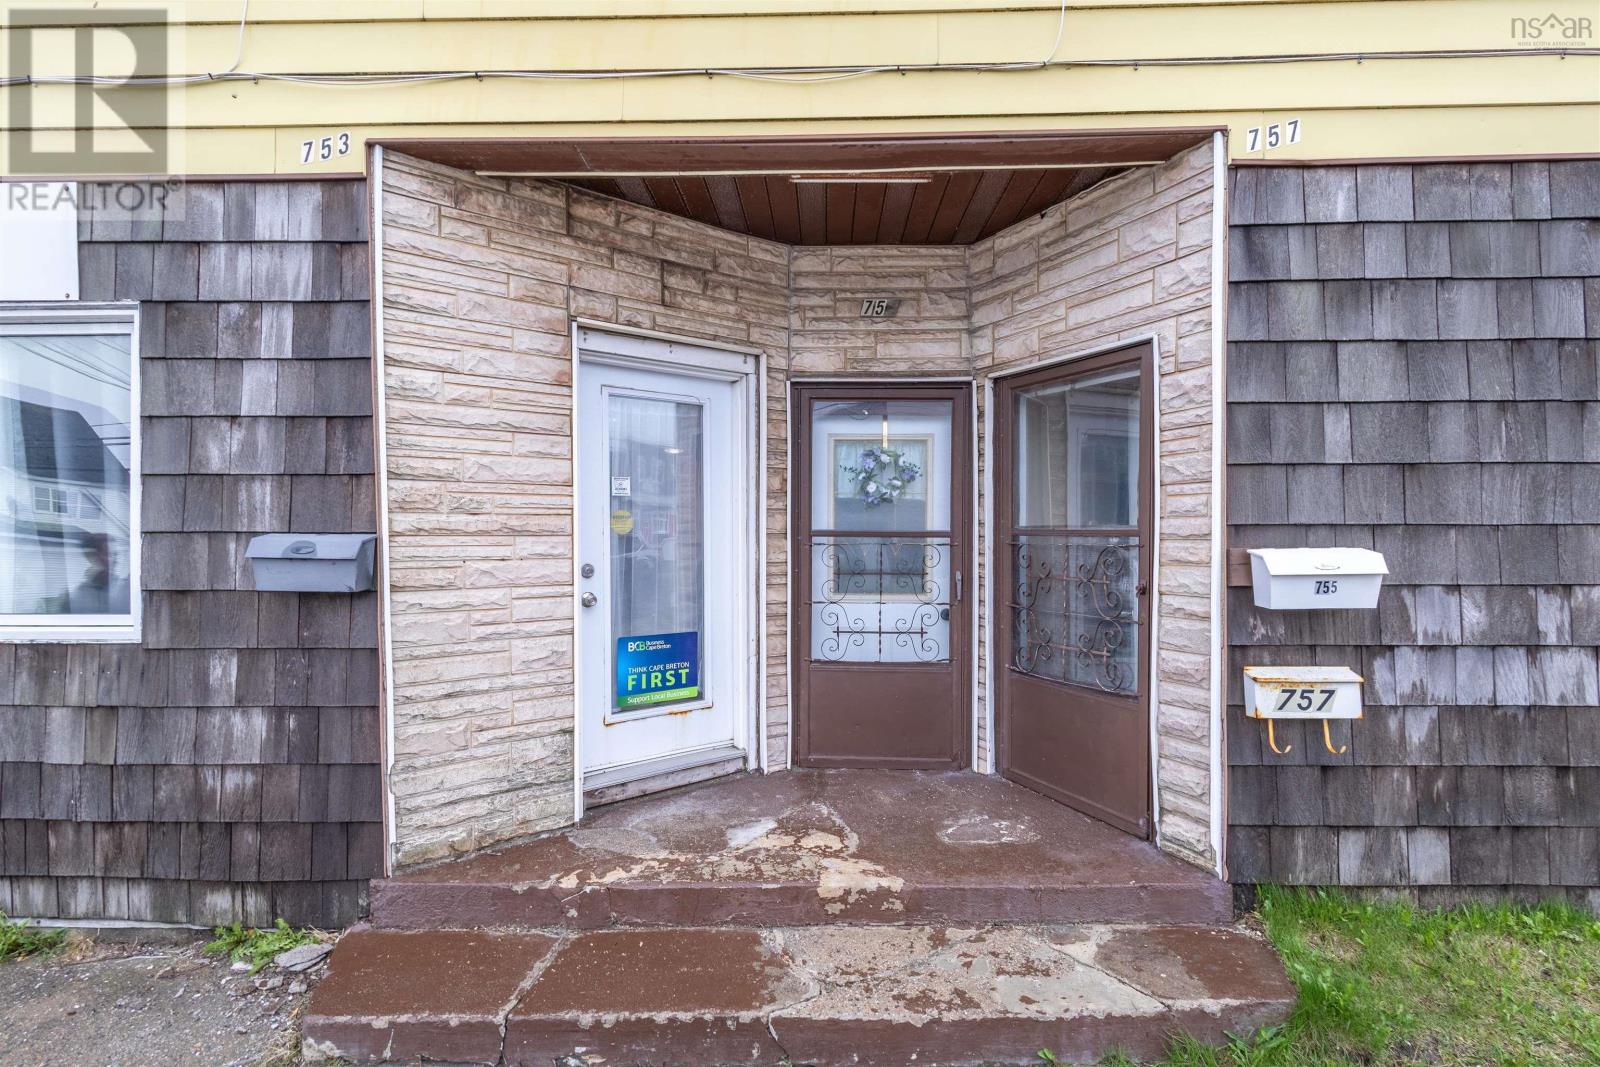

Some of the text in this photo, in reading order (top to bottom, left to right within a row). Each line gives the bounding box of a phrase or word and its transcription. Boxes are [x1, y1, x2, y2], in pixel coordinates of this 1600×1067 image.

[1249, 120, 1299, 151] 757
[303, 132, 350, 163] 753
[1315, 580, 1338, 594] 755
[628, 666, 647, 674] THINK
[666, 661, 689, 670] BRETON
[627, 668, 689, 691] FIRST
[627, 690, 689, 704] Support Local Business
[1277, 689, 1336, 711] 757
